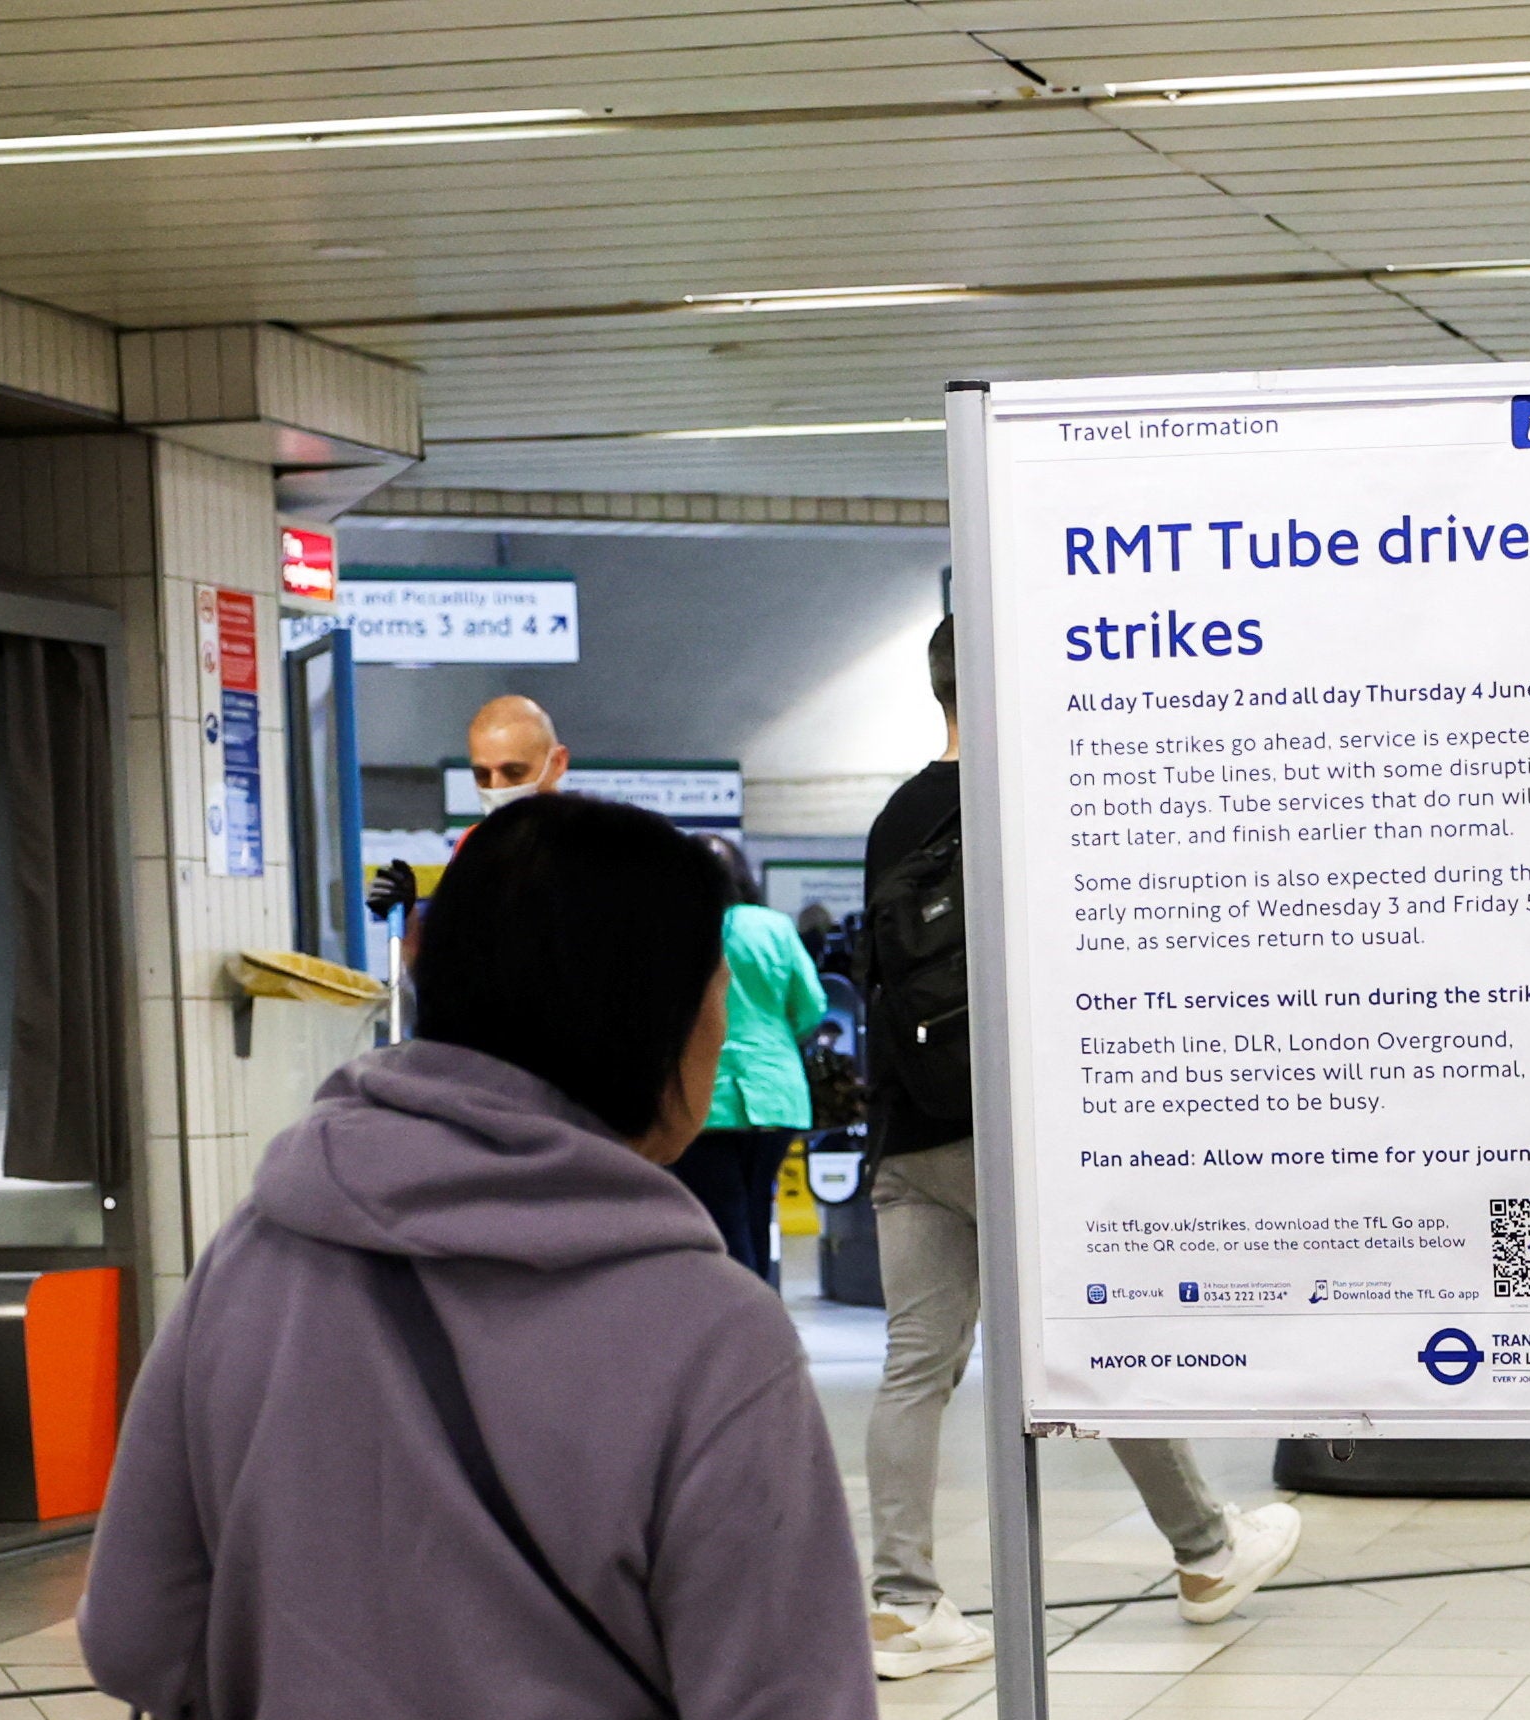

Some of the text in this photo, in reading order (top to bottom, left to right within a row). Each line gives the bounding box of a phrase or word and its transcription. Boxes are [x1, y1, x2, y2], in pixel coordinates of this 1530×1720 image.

[1058, 416, 1279, 442] Travel information
[1065, 521, 1193, 577] RMT
[1208, 517, 1359, 571] Tube
[362, 588, 395, 605] and
[401, 588, 486, 607] Piccadilly
[493, 589, 538, 605] lines
[437, 612, 452, 637] 3
[464, 613, 513, 637] and
[522, 614, 539, 636] 4
[1066, 608, 1263, 662] strikes
[1067, 692, 1097, 713] All
[1100, 692, 1137, 715] day
[1141, 689, 1229, 713] Tuesday
[1234, 687, 1244, 707] 2
[1249, 686, 1287, 707] and
[1292, 685, 1319, 706] all
[1322, 685, 1361, 708] day
[1365, 682, 1467, 706] Thursday
[1471, 681, 1483, 700] 4
[1075, 992, 1138, 1012] Other
[1143, 990, 1178, 1010] TfL
[1184, 990, 1270, 1010] services
[1276, 988, 1318, 1008] will
[1325, 992, 1361, 1008] run
[1368, 986, 1438, 1010] during
[1444, 985, 1481, 1005] the
[1080, 1150, 1123, 1169] Plan
[1129, 1149, 1195, 1168] ahead:
[1203, 1148, 1264, 1167] Allow
[1271, 1150, 1325, 1166] more
[1330, 1146, 1379, 1165] time
[1385, 1145, 1416, 1165] for
[1422, 1148, 1471, 1168] your
[1086, 1215, 1449, 1236] Visit tfl.gov.uk/strikes, download the TfL Go app,
[1111, 1287, 1164, 1302] tfl.gov.uk
[1203, 1290, 1231, 1303] 0343
[1234, 1290, 1255, 1302] 222
[1333, 1287, 1480, 1301] Download the TfL Go app
[1090, 1353, 1247, 1370] MAYOR OF LONDON
[1492, 1351, 1522, 1366] FOR
[1492, 1375, 1517, 1384] EVERY
